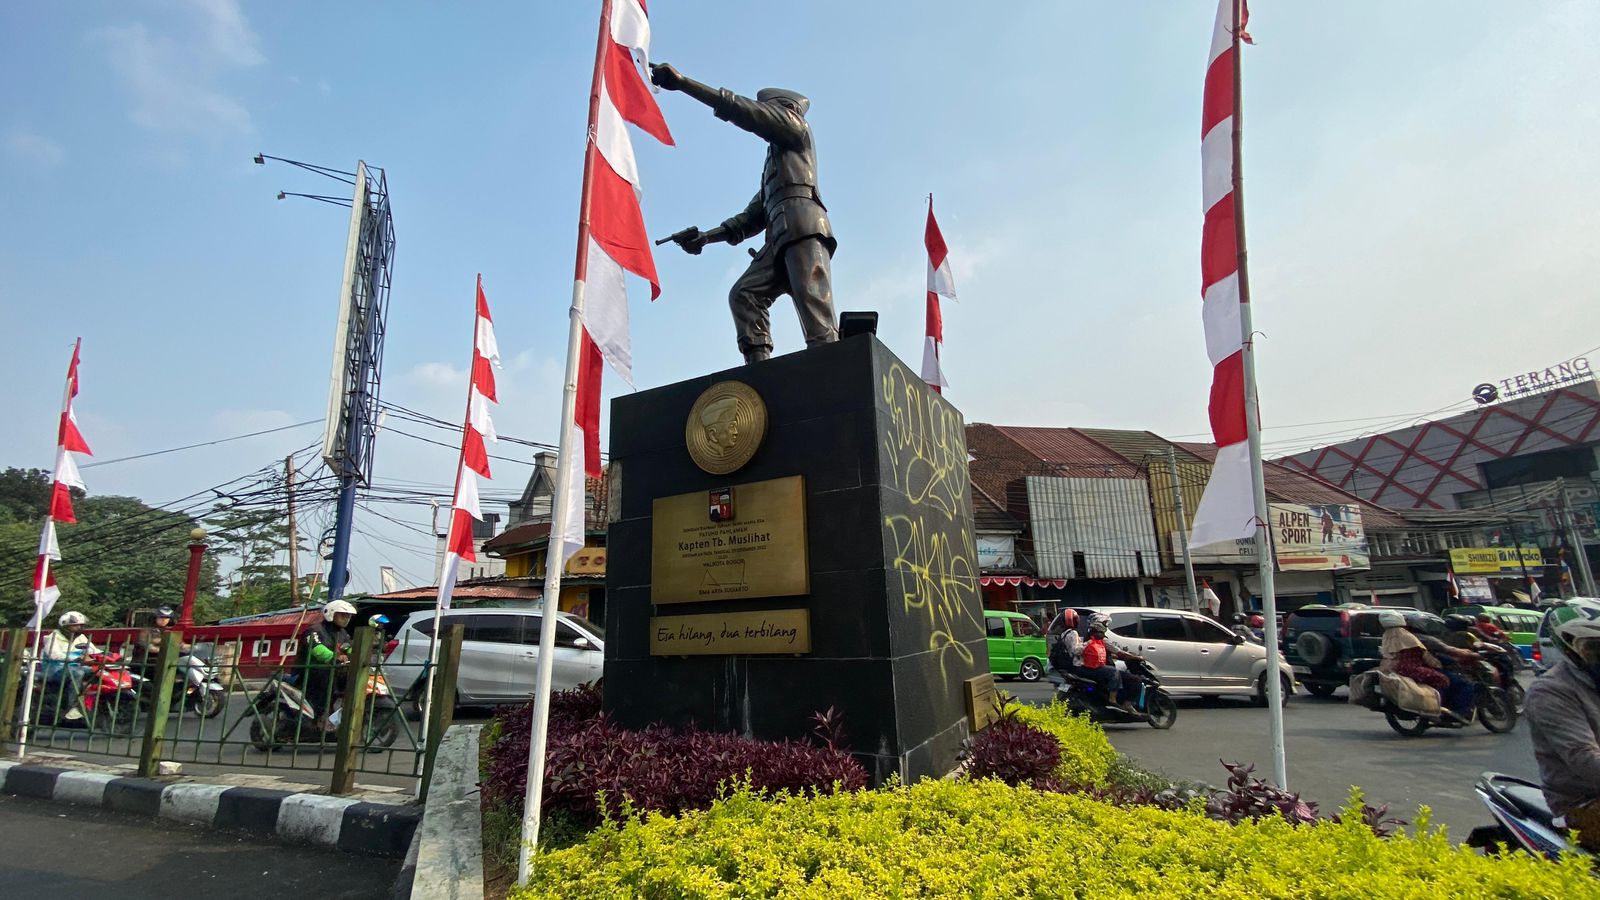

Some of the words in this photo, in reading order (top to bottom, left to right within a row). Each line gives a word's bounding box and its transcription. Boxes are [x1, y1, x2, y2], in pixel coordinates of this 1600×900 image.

[1500, 358, 1589, 390] TERANG
[1279, 511, 1310, 528] ALPEN
[678, 539, 710, 552] Kapten
[712, 537, 727, 547] Tb.
[728, 532, 771, 545] Muslihat
[1281, 528, 1313, 544] SPORT
[1468, 553, 1497, 563] SHIMIZU
[657, 627, 675, 642] Esa
[679, 624, 715, 646] hilang,
[720, 622, 740, 639] dua
[744, 620, 797, 644] terbilang
